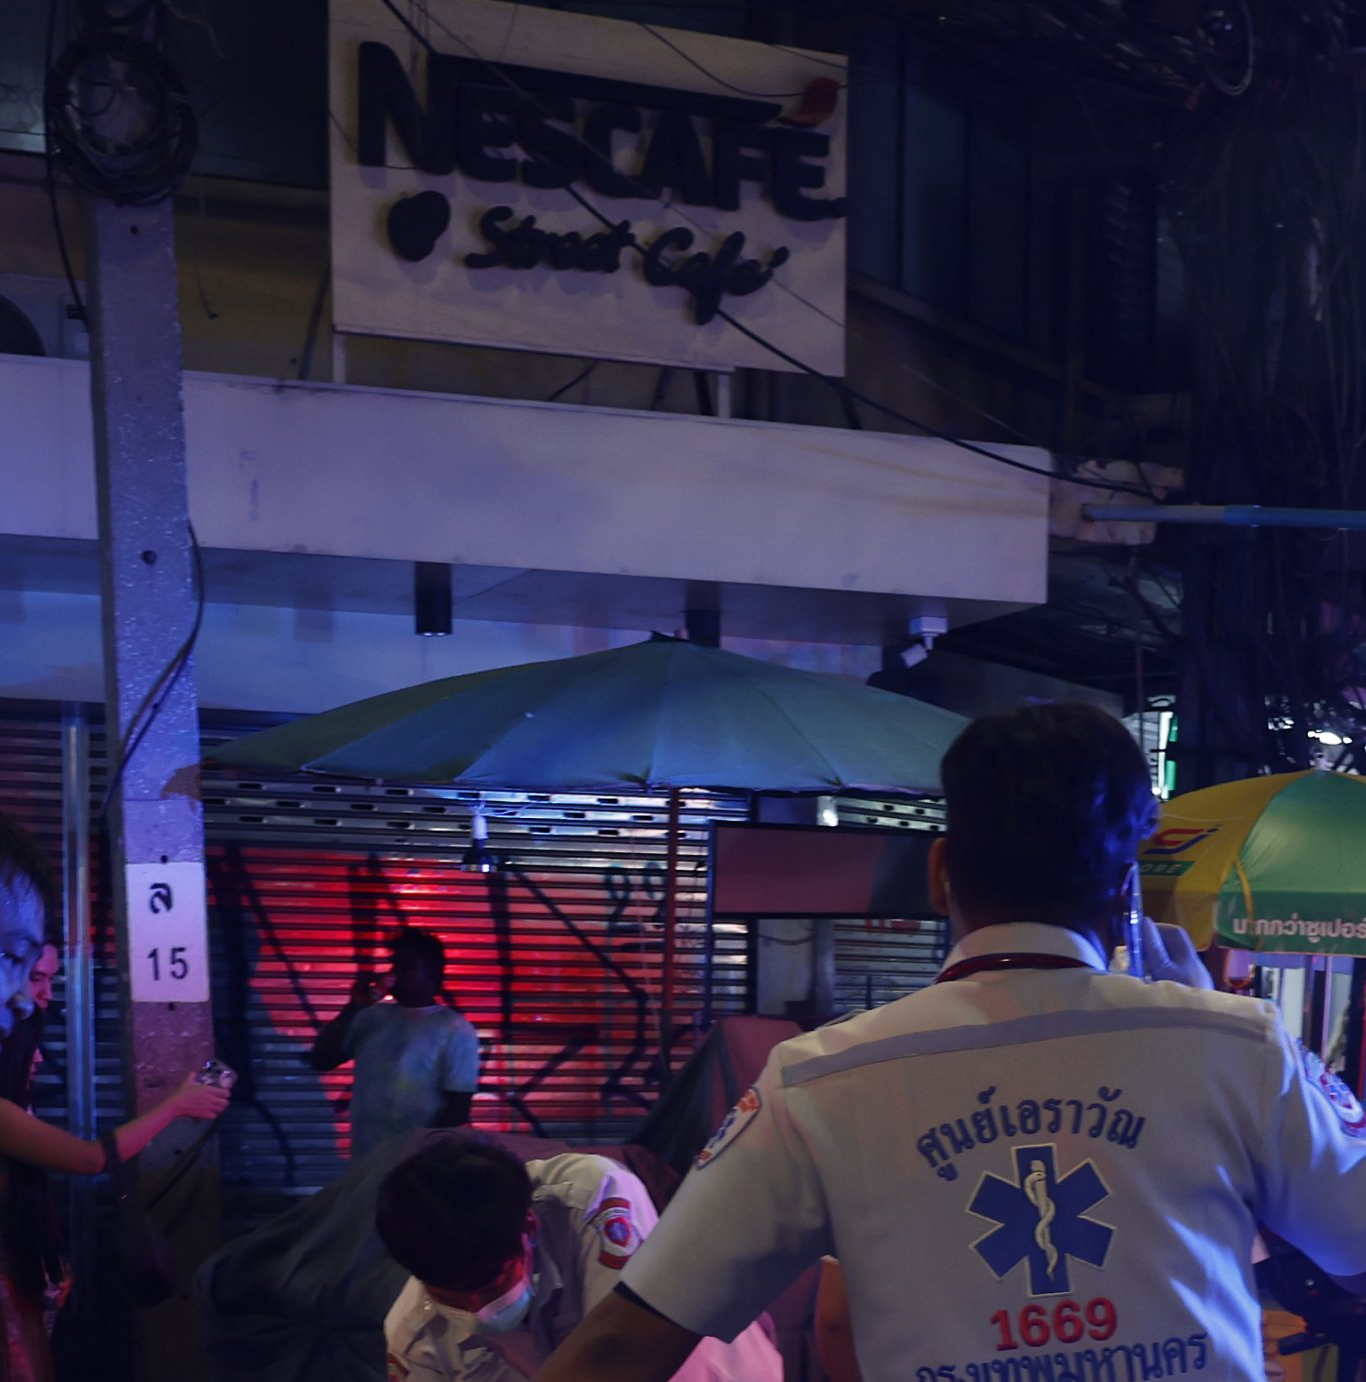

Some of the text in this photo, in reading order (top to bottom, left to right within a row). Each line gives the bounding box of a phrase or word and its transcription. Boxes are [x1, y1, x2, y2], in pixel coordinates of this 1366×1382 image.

[464, 206, 635, 274] Street
[1140, 863, 1182, 875] ORE
[149, 882, 173, 914] ล
[147, 946, 188, 981] 15
[916, 1086, 1146, 1181] ศูนย์เอราวัณ
[990, 1297, 1117, 1352] 1669
